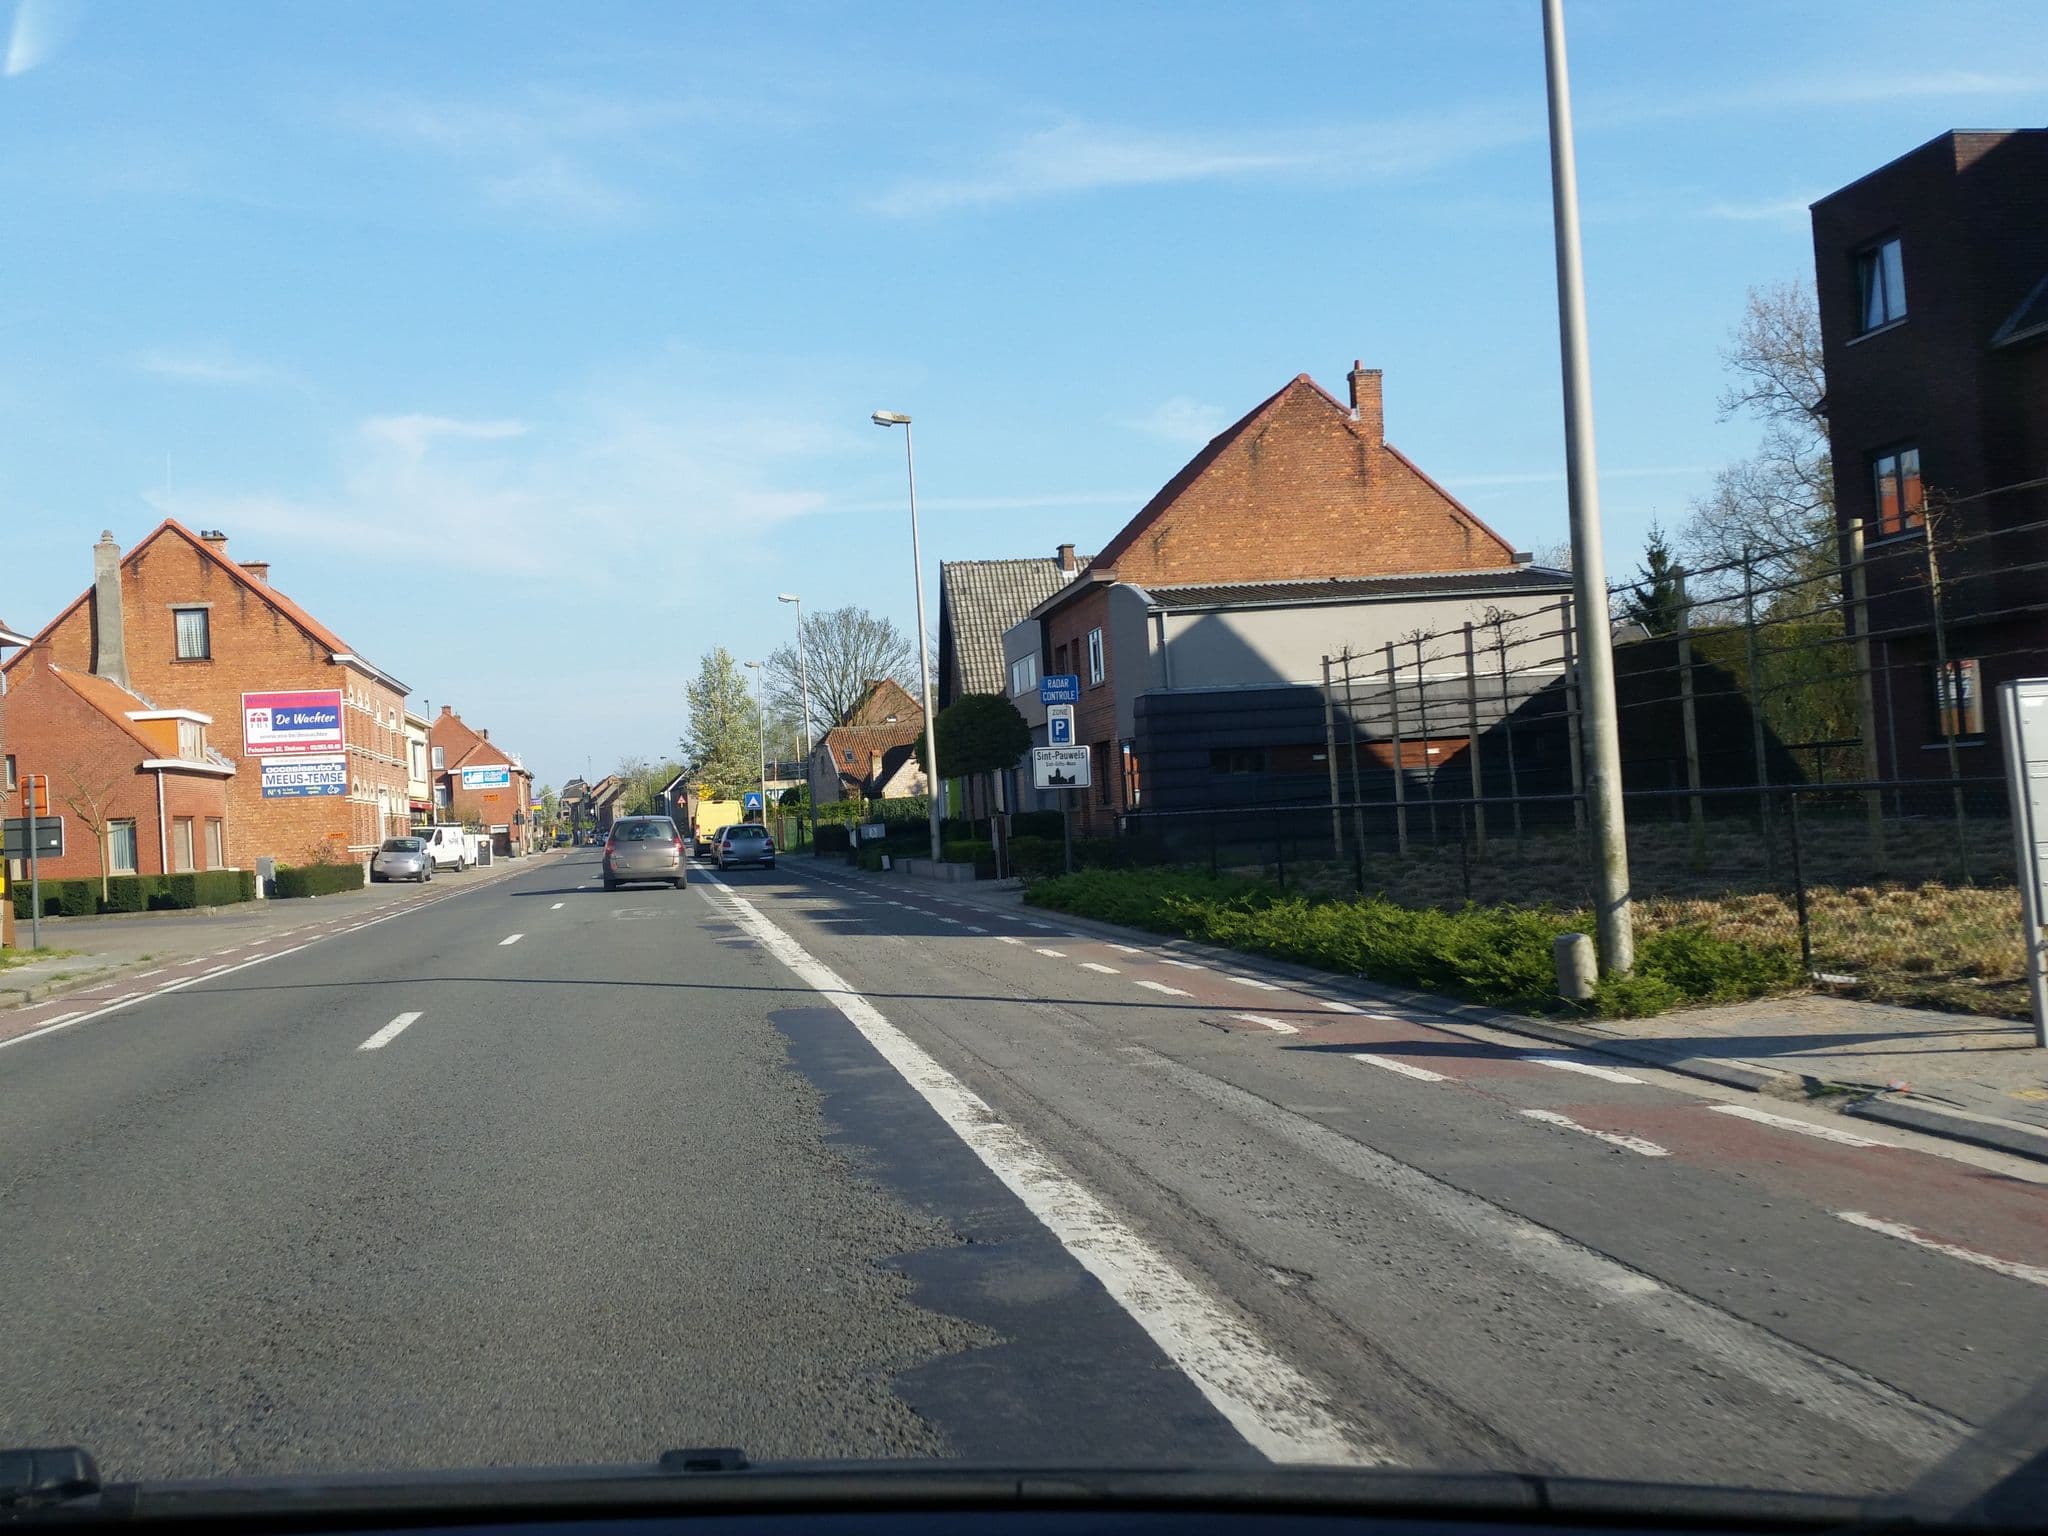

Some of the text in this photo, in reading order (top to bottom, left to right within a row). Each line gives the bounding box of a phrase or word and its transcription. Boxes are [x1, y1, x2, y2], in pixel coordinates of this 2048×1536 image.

[1047, 678, 1069, 689] RADAR
[1042, 690, 1076, 701] CONTROLE
[1052, 708, 1068, 716] ZONE
[275, 711, 336, 725] De Wachter
[1055, 721, 1065, 736] P
[1036, 750, 1085, 761] Sint-Pauwels
[265, 772, 343, 785] MEEUS-TEMSE
